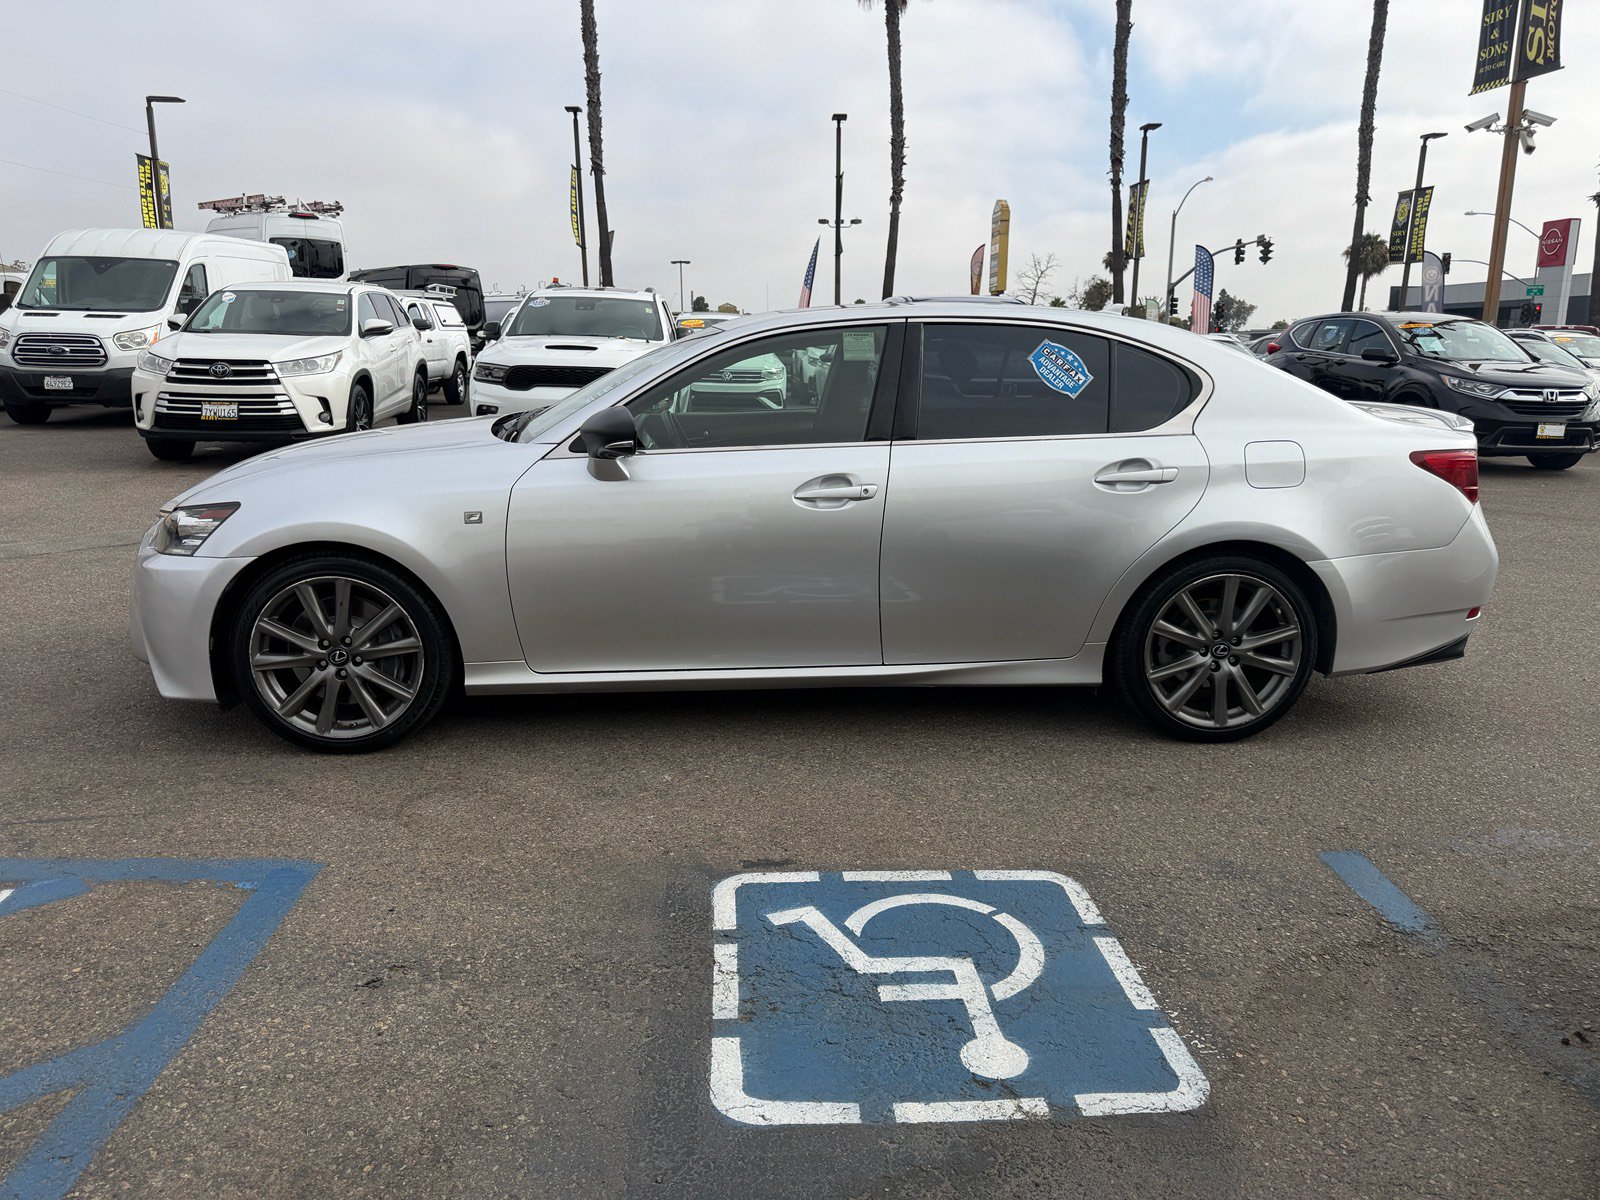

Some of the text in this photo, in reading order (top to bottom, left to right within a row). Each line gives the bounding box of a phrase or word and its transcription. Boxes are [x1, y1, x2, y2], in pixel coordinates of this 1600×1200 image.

[1484, 5, 1512, 26] SIRY
[1490, 28, 1500, 40] &
[1480, 42, 1508, 61] SONS
[1478, 60, 1506, 74] AUTO CARE
[138, 164, 150, 228] AUTO CARE
[147, 190, 156, 229] SERVIC
[1410, 197, 1424, 255] AUTO CARE
[1416, 189, 1432, 261] FULL SERVICE
[1541, 238, 1564, 246] NISSAN
[1038, 356, 1076, 389] ADVANTAGE
[1042, 347, 1086, 384] CARFAX
[46, 380, 72, 388] 64929E2
[1038, 366, 1065, 390] DEALER
[204, 408, 237, 418] 7YWU165
